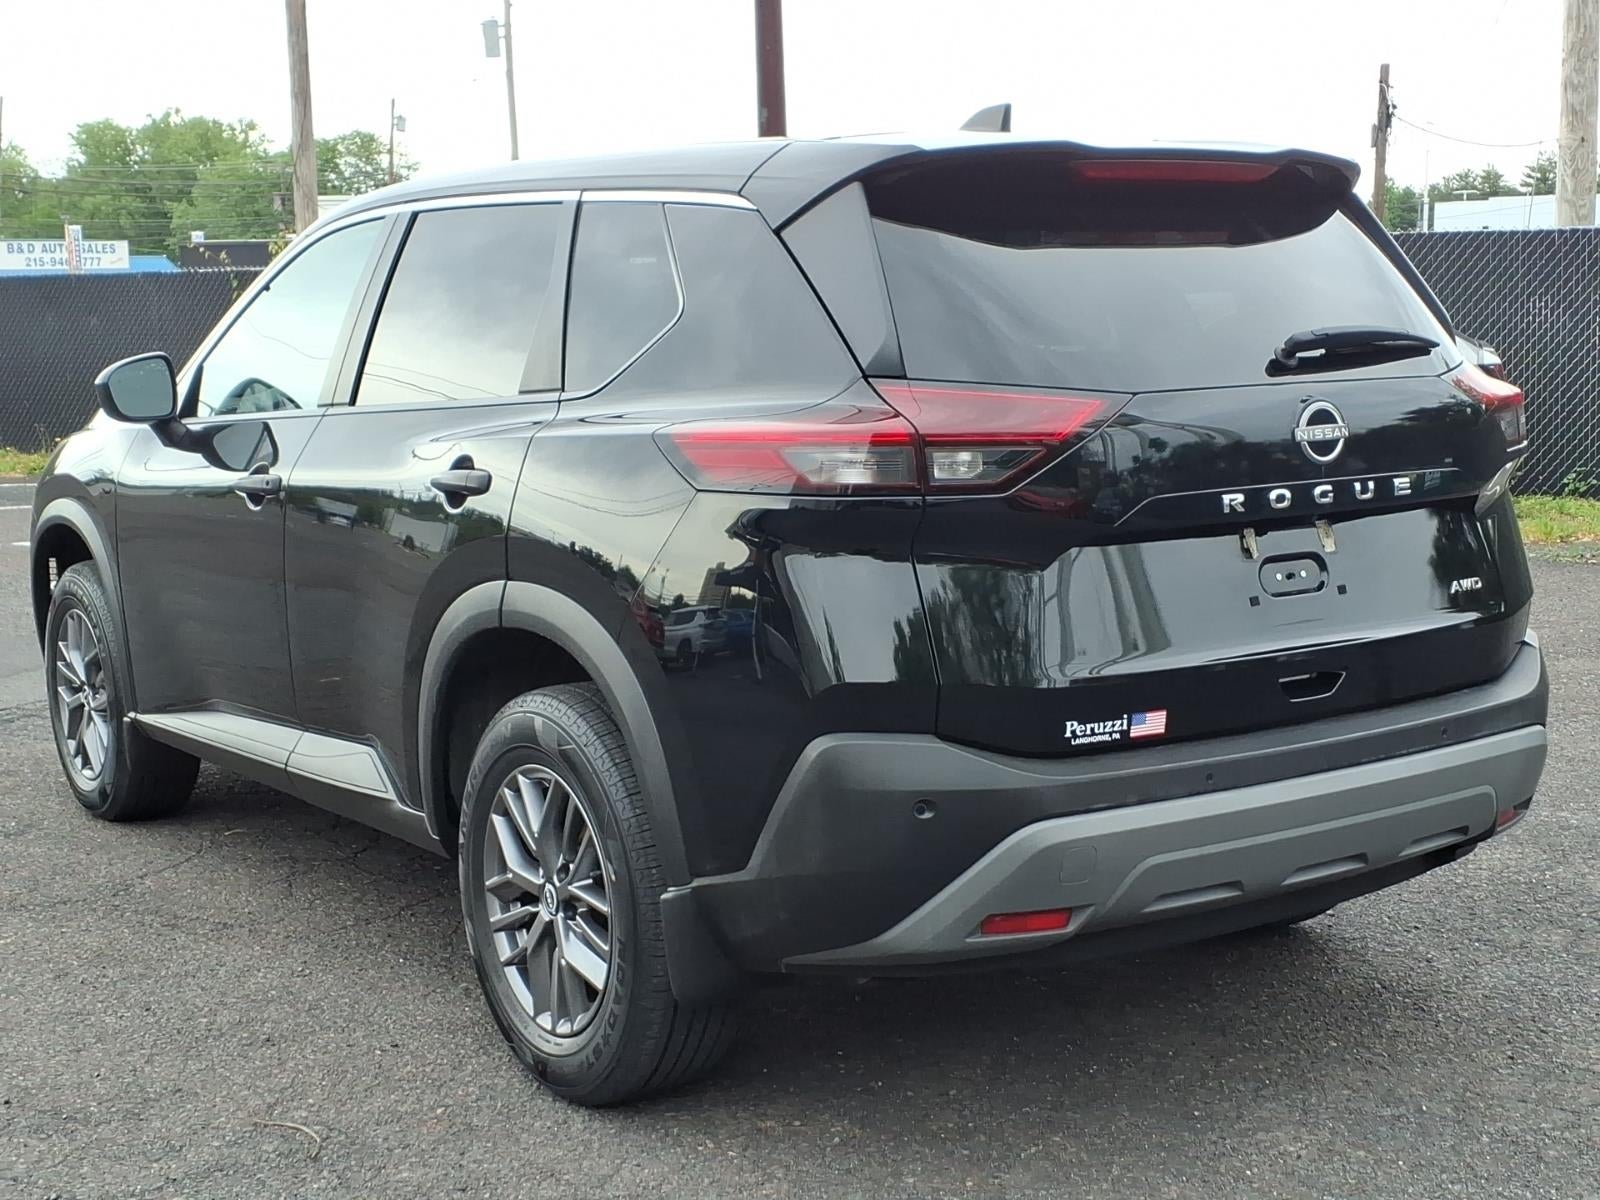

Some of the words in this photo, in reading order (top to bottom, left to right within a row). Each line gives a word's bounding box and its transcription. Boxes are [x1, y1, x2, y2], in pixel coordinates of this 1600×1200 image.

[7, 243, 35, 254] B&D
[1296, 425, 1349, 442] NISSAN
[1221, 476, 1412, 513] ROGUE
[1450, 576, 1482, 594] AWD
[1064, 714, 1128, 738] Peruzzi
[1112, 732, 1121, 740] PA
